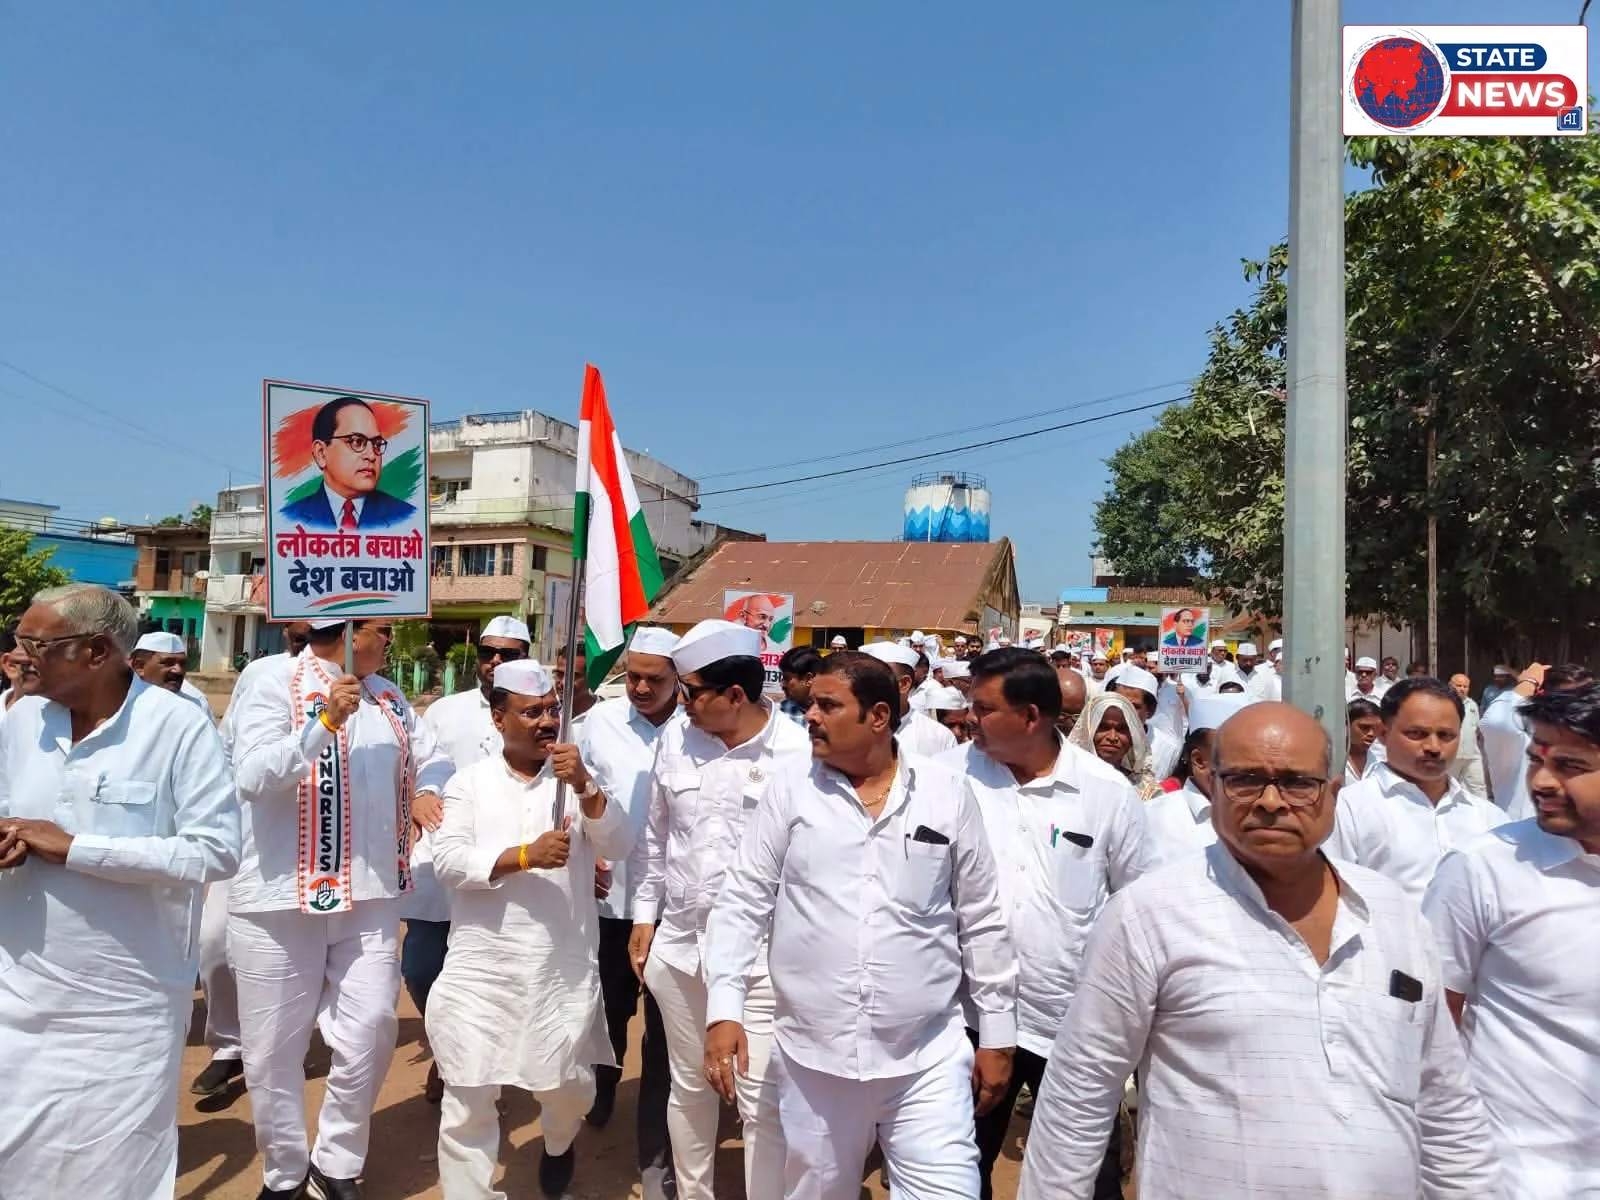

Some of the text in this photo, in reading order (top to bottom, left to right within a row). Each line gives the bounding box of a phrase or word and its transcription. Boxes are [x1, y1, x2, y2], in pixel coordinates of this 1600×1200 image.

[276, 524, 423, 560] लोकतंत्र बचाओ
[288, 559, 416, 597] देश बचाओ
[319, 744, 334, 873] ONGRESS
